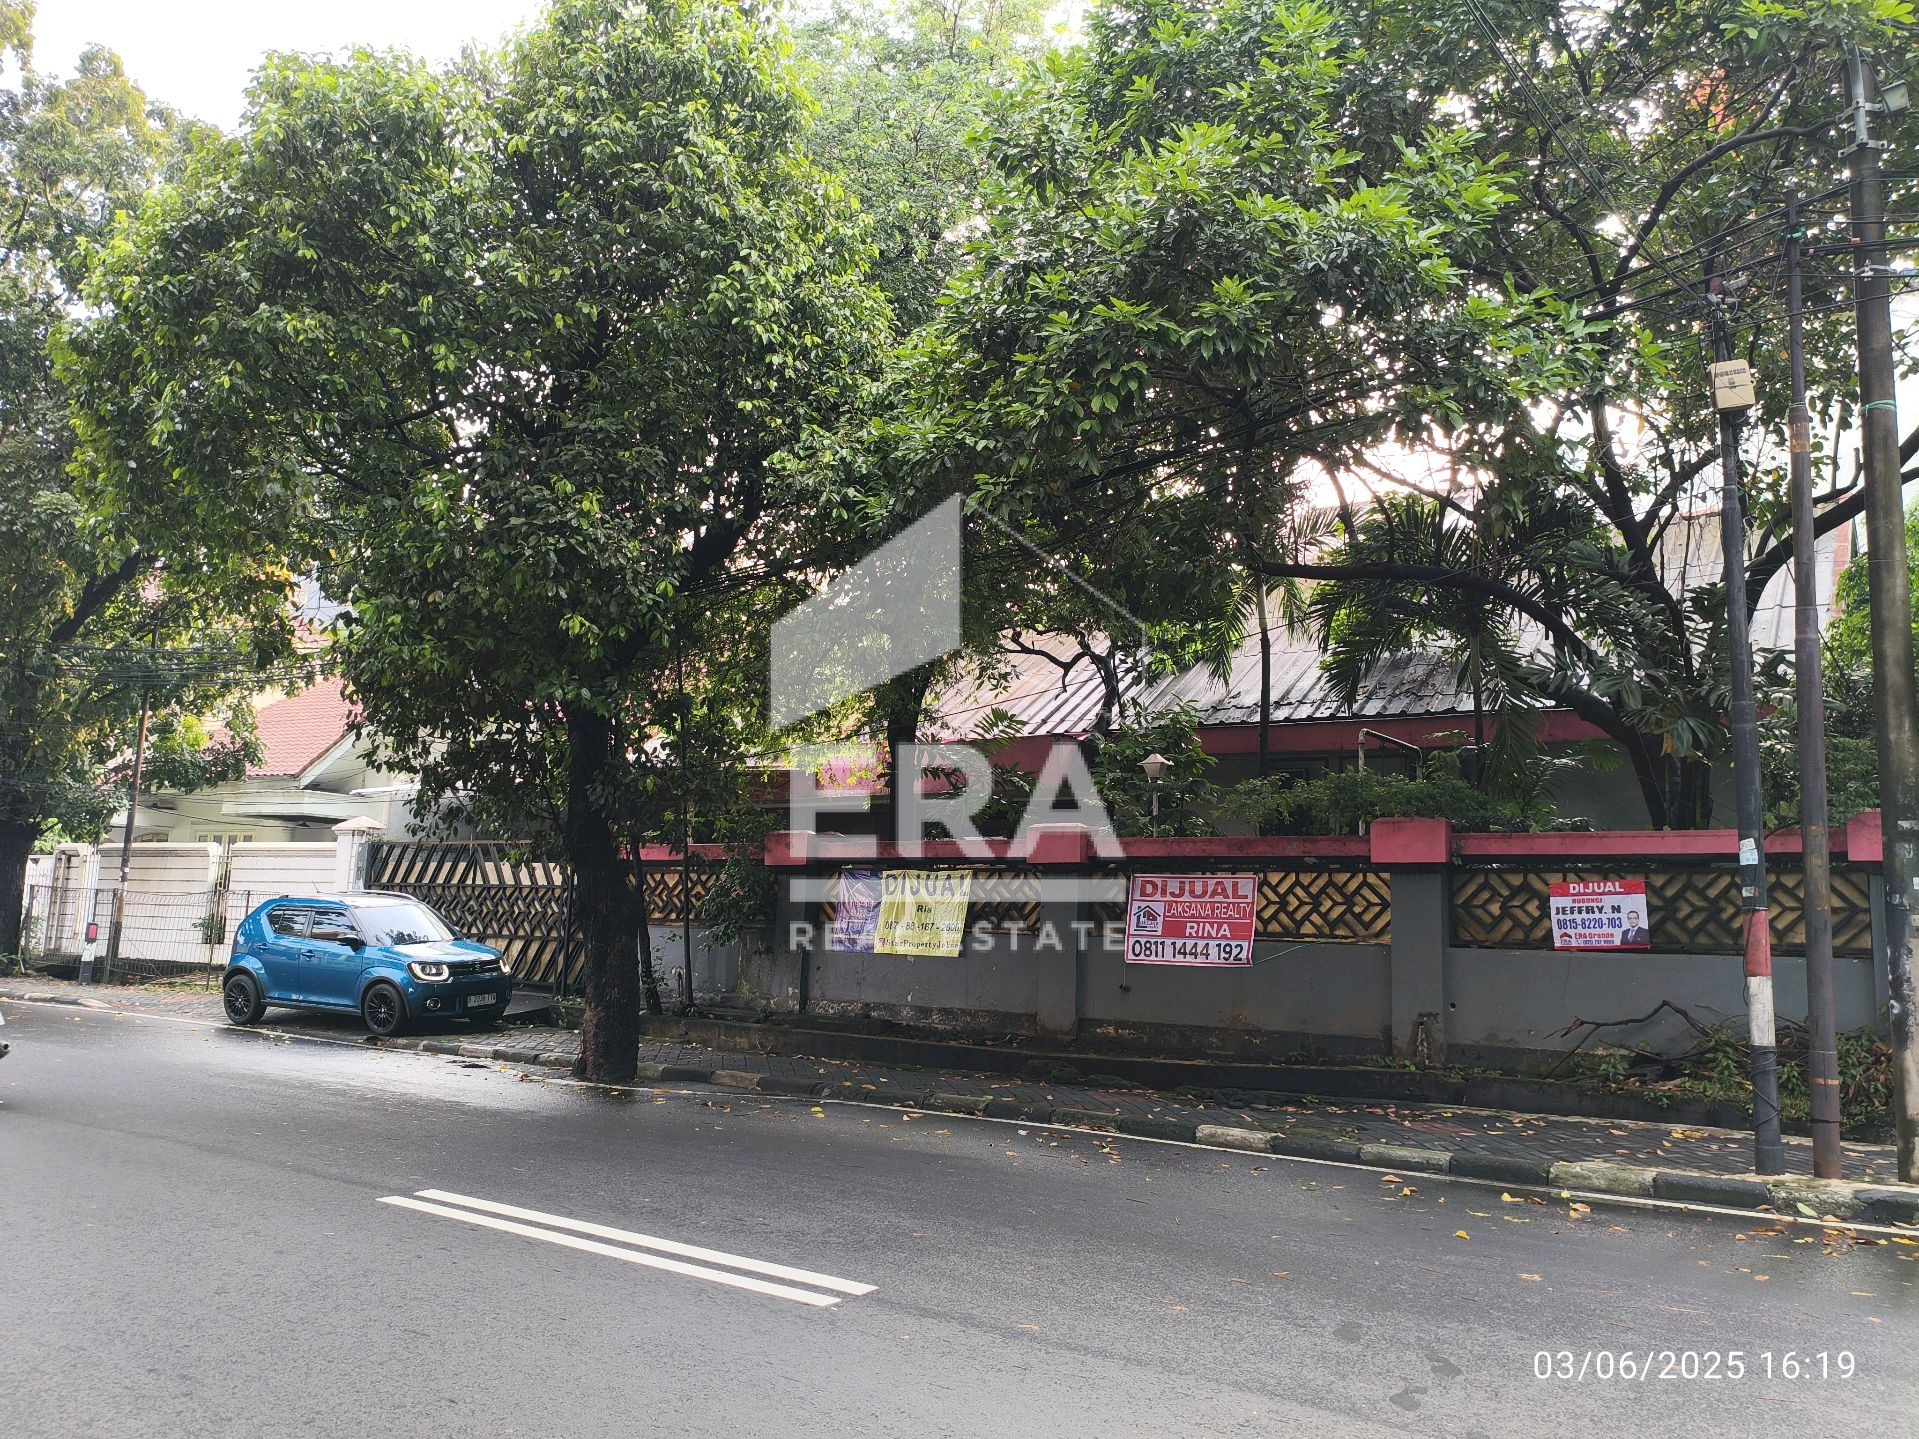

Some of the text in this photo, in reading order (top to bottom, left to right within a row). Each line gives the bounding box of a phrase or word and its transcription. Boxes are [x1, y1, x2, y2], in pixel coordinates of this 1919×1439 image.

[885, 873, 969, 898] DIJUAL
[1139, 879, 1249, 900] DIJUAL
[1569, 881, 1624, 894] DIJUAL
[1165, 902, 1252, 918] LAKSANA REALTY
[1555, 904, 1622, 916] JEFFRY. N
[1185, 922, 1232, 938] RINA
[1557, 917, 1623, 930] 0815-8220-703
[1131, 939, 1244, 962] 0811 1444 192
